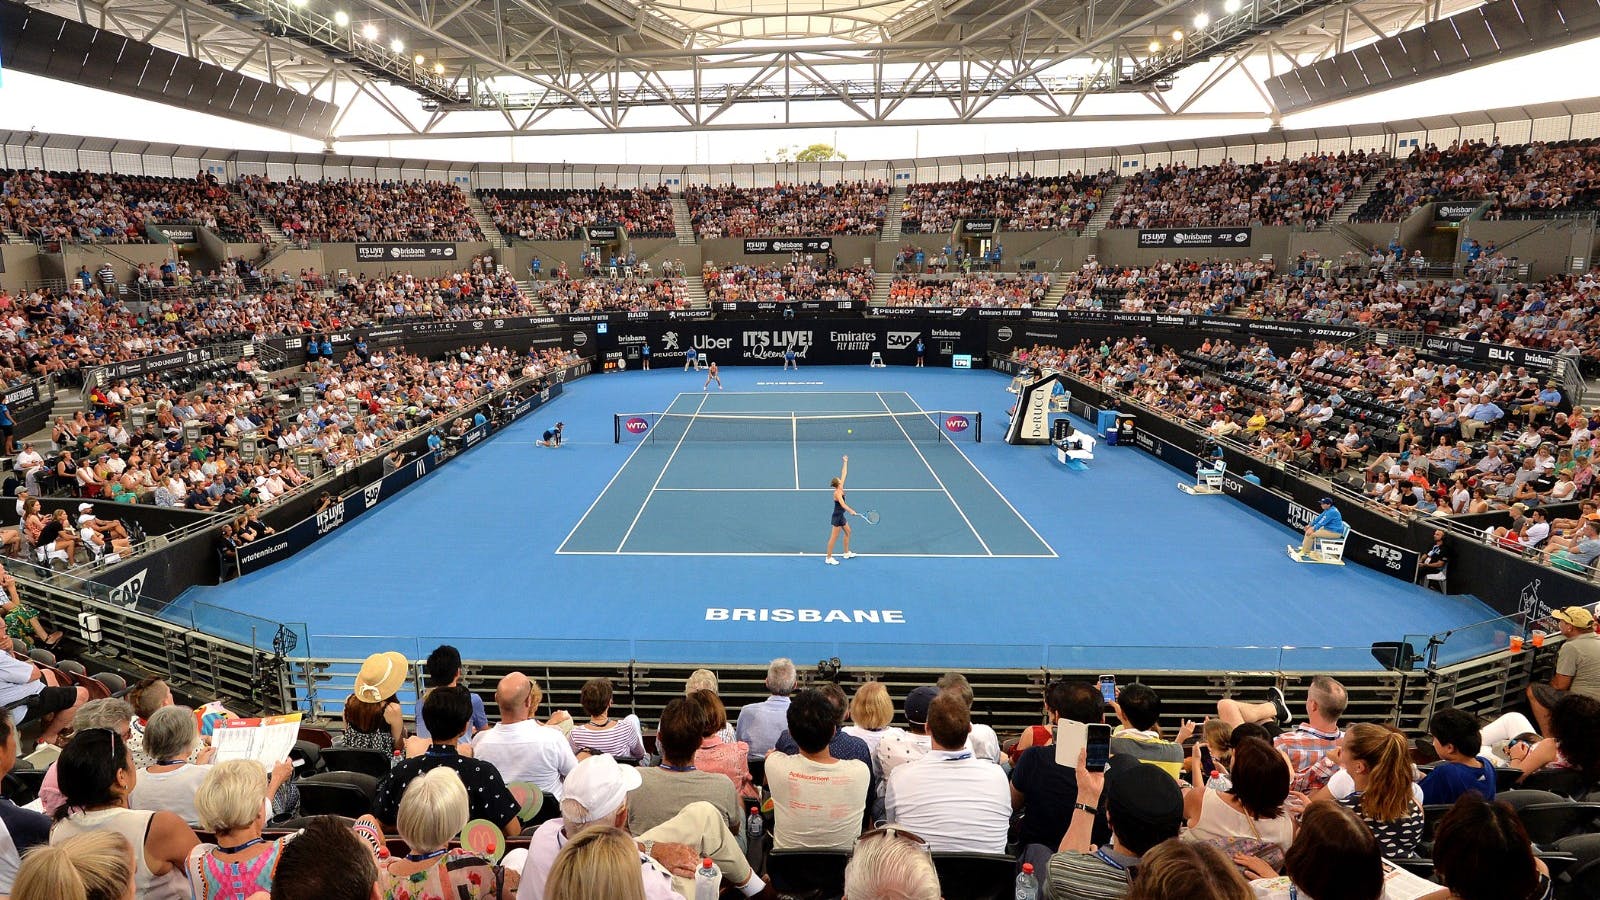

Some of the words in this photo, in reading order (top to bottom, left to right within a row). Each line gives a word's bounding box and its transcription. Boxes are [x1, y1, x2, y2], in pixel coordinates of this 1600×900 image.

[331, 333, 351, 342] BLK
[743, 331, 770, 346] IT'S
[773, 331, 813, 346] LIVE!
[830, 331, 876, 341] Emirates
[888, 335, 912, 345] SAP
[1316, 329, 1355, 337] DUNLOP
[694, 335, 732, 349] Uber
[837, 342, 846, 350] FLY
[848, 342, 870, 350] BETTER
[752, 342, 808, 360] Queenslnd
[1488, 348, 1514, 361] BLK
[1032, 389, 1044, 437] DeRUCCI
[366, 487, 378, 503] SAP
[316, 511, 329, 526] IT'S
[329, 502, 344, 519] LIVE!
[1288, 503, 1301, 519] IT'S
[242, 541, 288, 564] wtatennis.com
[1368, 544, 1402, 561] ATP
[1386, 560, 1401, 570] 250
[111, 579, 140, 604] SAP
[705, 608, 906, 623] BRISBANE
